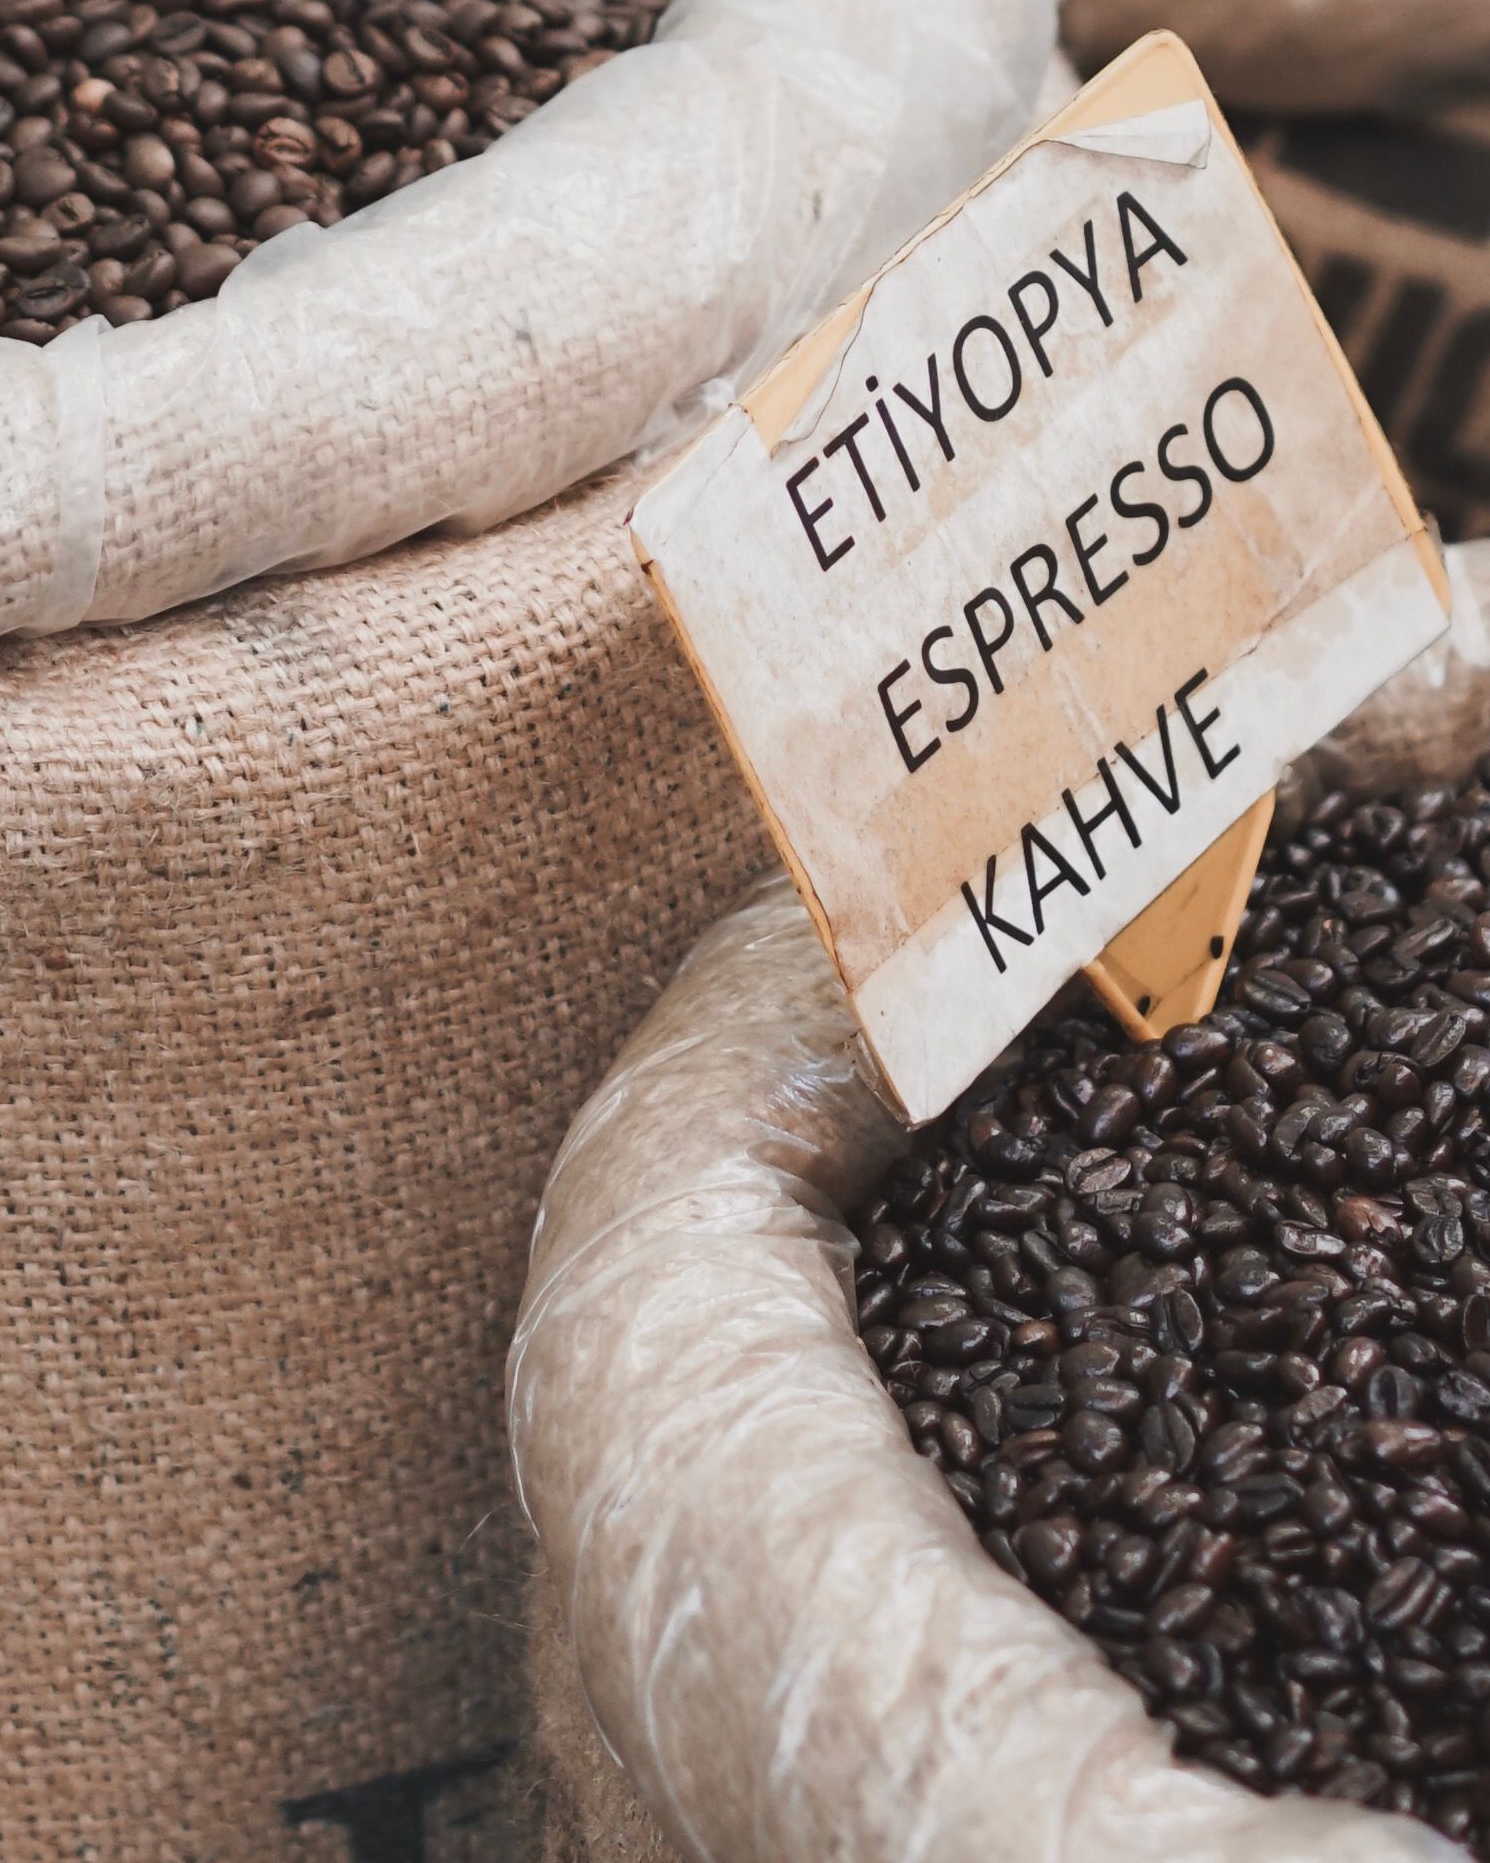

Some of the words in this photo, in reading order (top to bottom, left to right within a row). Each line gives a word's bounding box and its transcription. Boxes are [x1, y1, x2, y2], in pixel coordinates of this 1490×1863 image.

[784, 189, 1190, 574] ETİYOPYA
[875, 375, 1277, 776] ESPRESSO
[958, 665, 1242, 976] KAHVE
